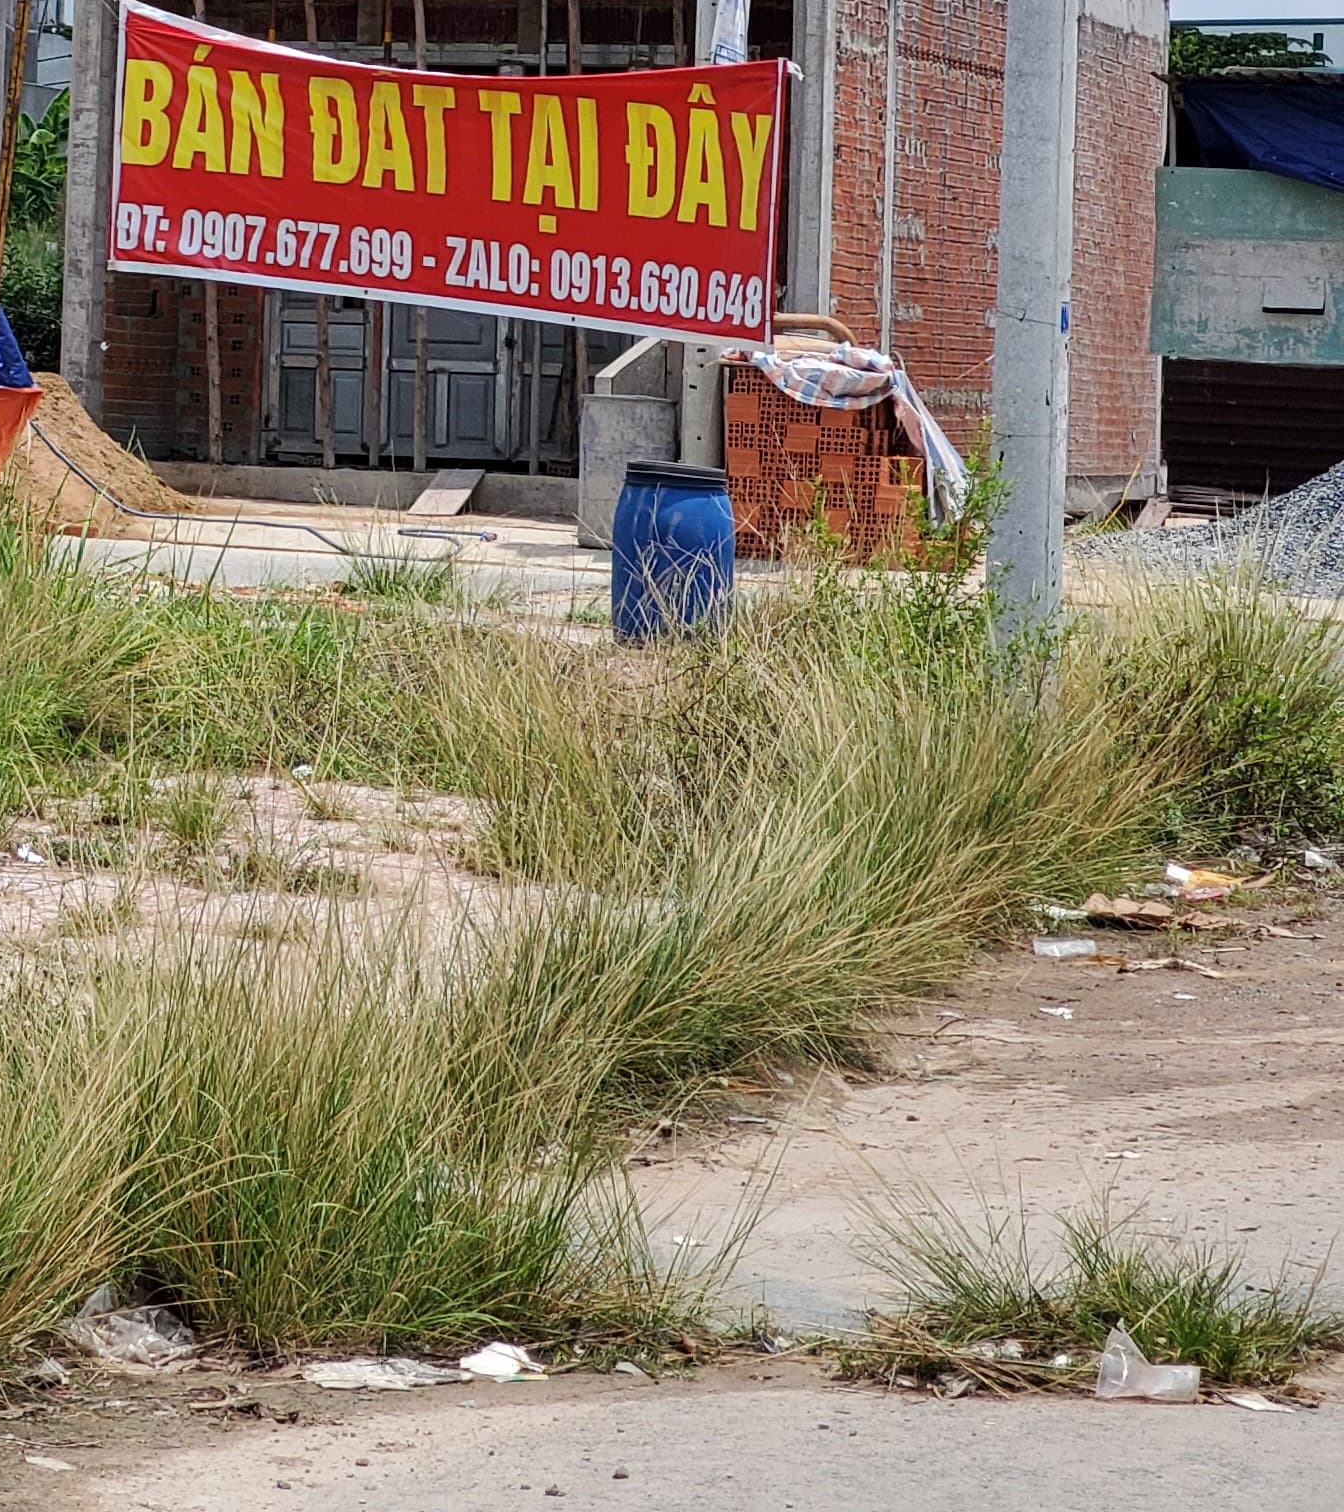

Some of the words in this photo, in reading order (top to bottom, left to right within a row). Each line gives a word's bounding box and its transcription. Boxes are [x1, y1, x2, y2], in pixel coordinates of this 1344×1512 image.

[121, 44, 285, 179] BÁN
[478, 89, 599, 234] TẠI
[625, 82, 773, 232] ĐÂY
[116, 201, 170, 253] ĐT:
[178, 208, 412, 281] 0907.677.699
[422, 255, 437, 268] -
[445, 235, 541, 297] ZALO:
[549, 248, 763, 329] 0913.630.648
